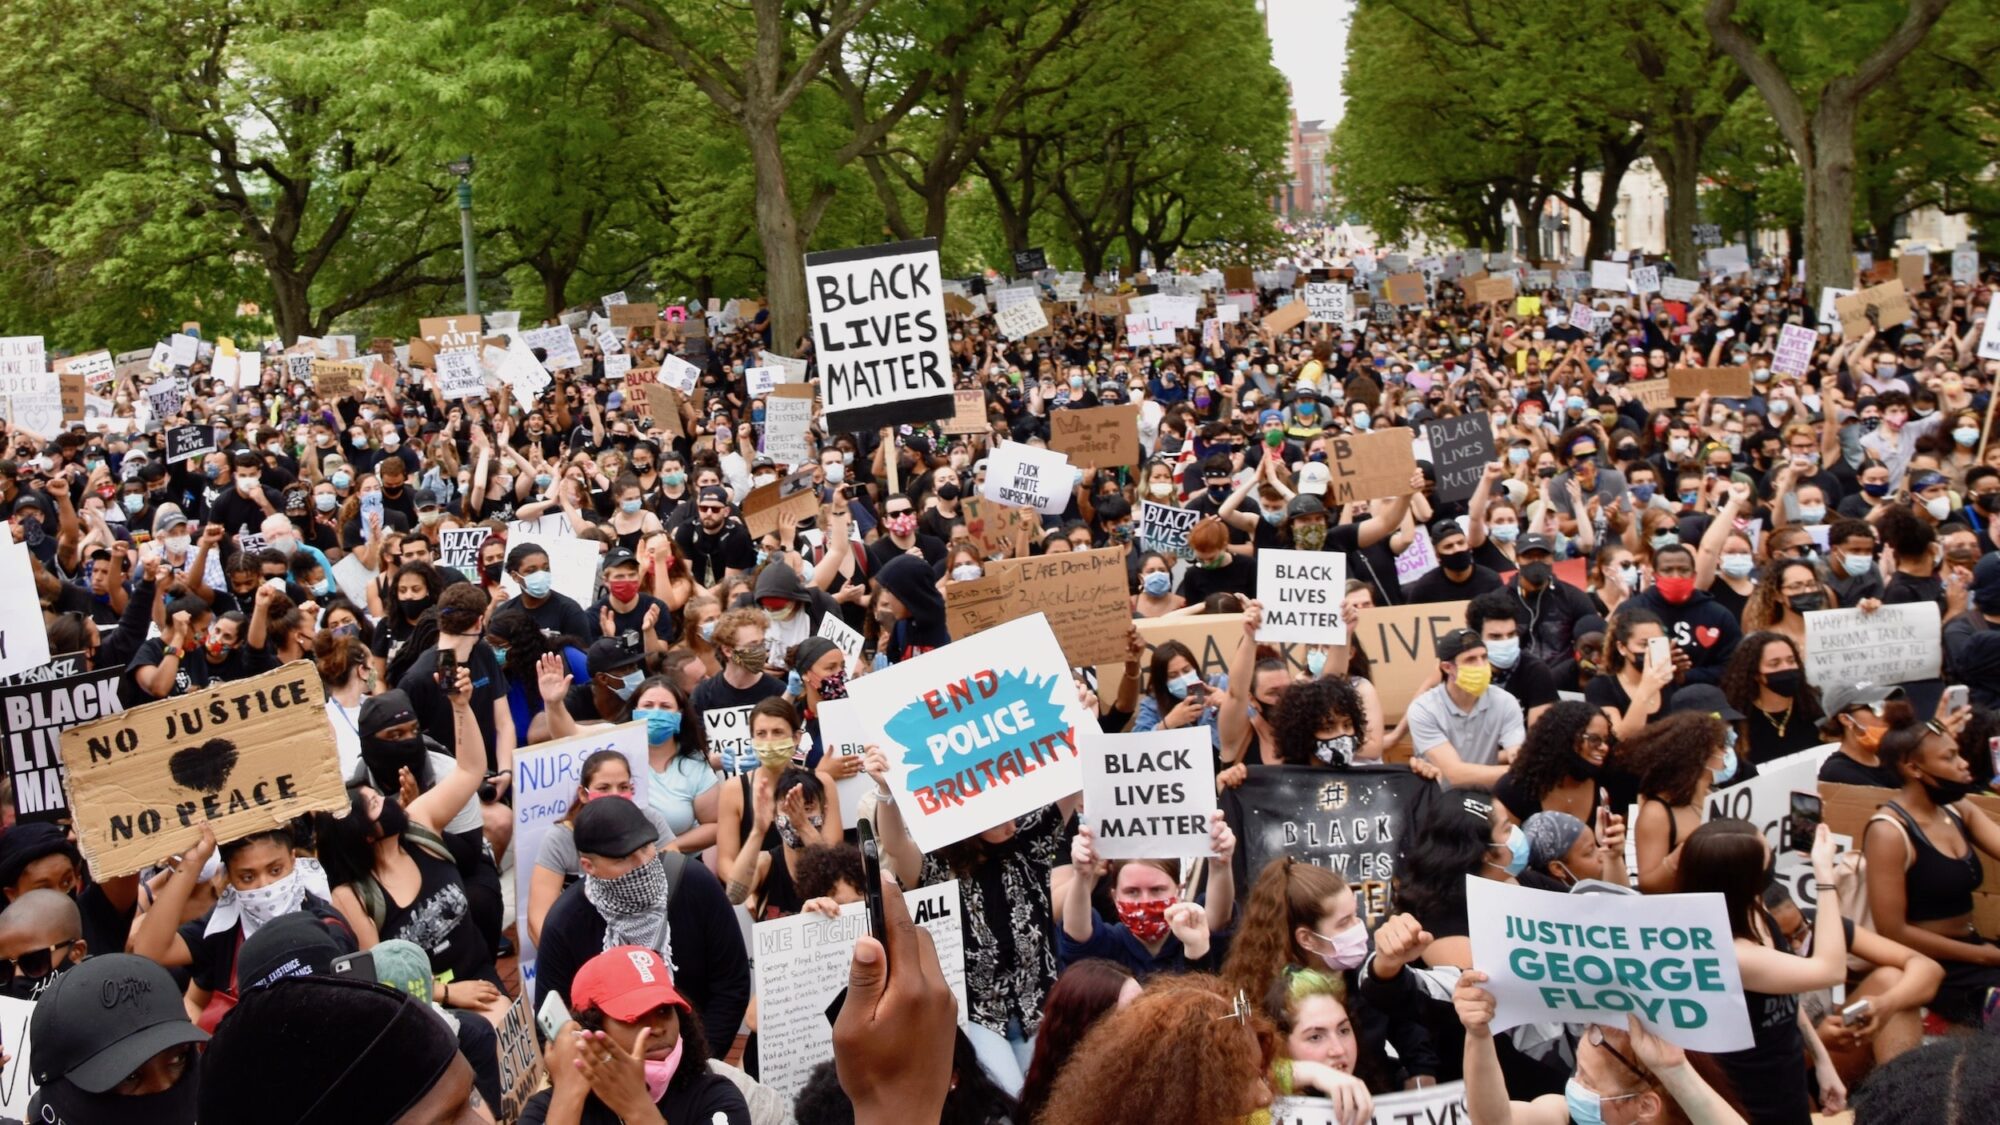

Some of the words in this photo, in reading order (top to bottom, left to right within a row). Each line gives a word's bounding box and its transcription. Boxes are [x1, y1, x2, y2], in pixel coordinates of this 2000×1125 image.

[817, 263, 931, 313] BLACK
[1307, 285, 1341, 295] BLACK
[1001, 302, 1031, 318] BLACK
[1307, 297, 1343, 307] LIVES
[447, 320, 457, 333] I
[820, 310, 938, 351] LIVES
[1005, 311, 1037, 329] LIVES
[1781, 337, 1809, 350] LIVES
[1784, 326, 1814, 341] BLACK
[626, 371, 658, 386] BLACK
[827, 350, 947, 405] MATTER
[769, 401, 805, 411] RESPECT
[955, 391, 983, 402] TOP
[768, 414, 810, 422] EXISTENCE
[1430, 418, 1482, 449] BLACK
[177, 438, 204, 453] ALIVE
[1442, 441, 1484, 465] LIVES
[1017, 462, 1039, 477] FUCK
[1442, 465, 1486, 490] MATTE
[1013, 476, 1039, 493] WHITE
[1000, 487, 1049, 508] SUPREMACY
[1146, 505, 1197, 530] BLACK
[445, 532, 486, 549] BLACK
[1144, 522, 1190, 546] LIVES
[1034, 562, 1057, 580] ARE
[1275, 564, 1332, 581] BLACK
[1279, 588, 1326, 604] LIVES
[1266, 610, 1338, 628] MATTER
[1812, 614, 1849, 631] HAPPY
[824, 619, 856, 655] BLACK
[1877, 625, 1916, 641] TAYLOR
[1815, 654, 1835, 665] WE
[4, 676, 124, 713] BLACK
[923, 669, 998, 720] END
[87, 727, 139, 763] NO
[166, 679, 310, 740] JUSTICE
[707, 708, 751, 728] VOT
[926, 699, 1035, 766] POLICE
[841, 743, 865, 756] Bla
[912, 725, 1079, 817] BRUTALITY
[1104, 749, 1192, 775] BLACK
[1114, 782, 1185, 806] LIVES
[1710, 786, 1752, 821] NO
[110, 808, 162, 842] NO
[176, 774, 298, 827] PEACE
[520, 800, 566, 823] STAND
[1100, 814, 1208, 838] MATTER
[1283, 815, 1393, 847] BLACK
[914, 896, 951, 924] ALL
[760, 927, 792, 956] WE
[802, 913, 867, 949] FIGHT
[1506, 915, 1630, 950] JUSTICE
[1639, 927, 1716, 950] FOR
[269, 958, 300, 982] EXISTENCE
[762, 962, 788, 973] George
[815, 950, 845, 961] Breonna
[1509, 948, 1726, 993] GEORGE
[765, 985, 790, 997] Jordan
[1538, 987, 1708, 1030] FLOYD
[496, 1000, 527, 1052] WANT
[500, 1029, 534, 1095] USTICE
[763, 1048, 797, 1061] Natasha
[800, 1049, 828, 1063] Brown
